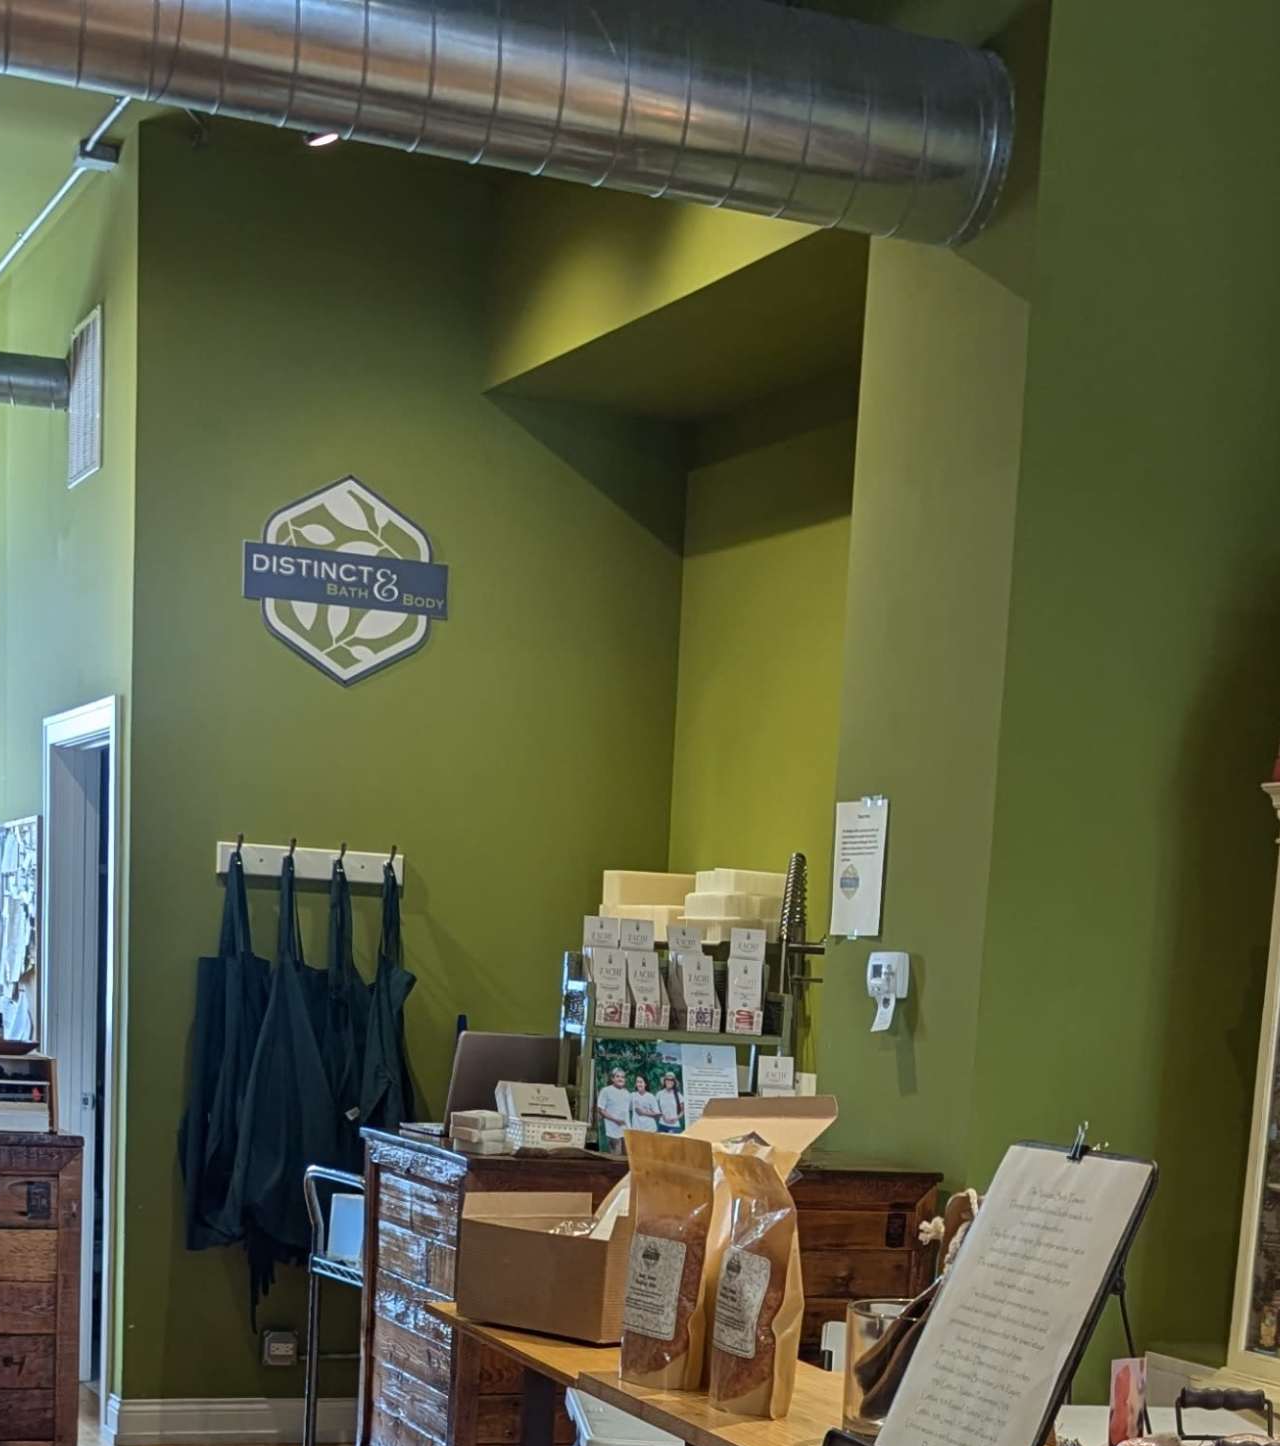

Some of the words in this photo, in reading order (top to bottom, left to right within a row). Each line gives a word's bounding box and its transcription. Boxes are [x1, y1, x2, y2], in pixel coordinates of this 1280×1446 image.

[252, 553, 373, 585] DISTINCT
[373, 567, 399, 602] &
[326, 583, 368, 599] BATH
[402, 593, 445, 610] BODY
